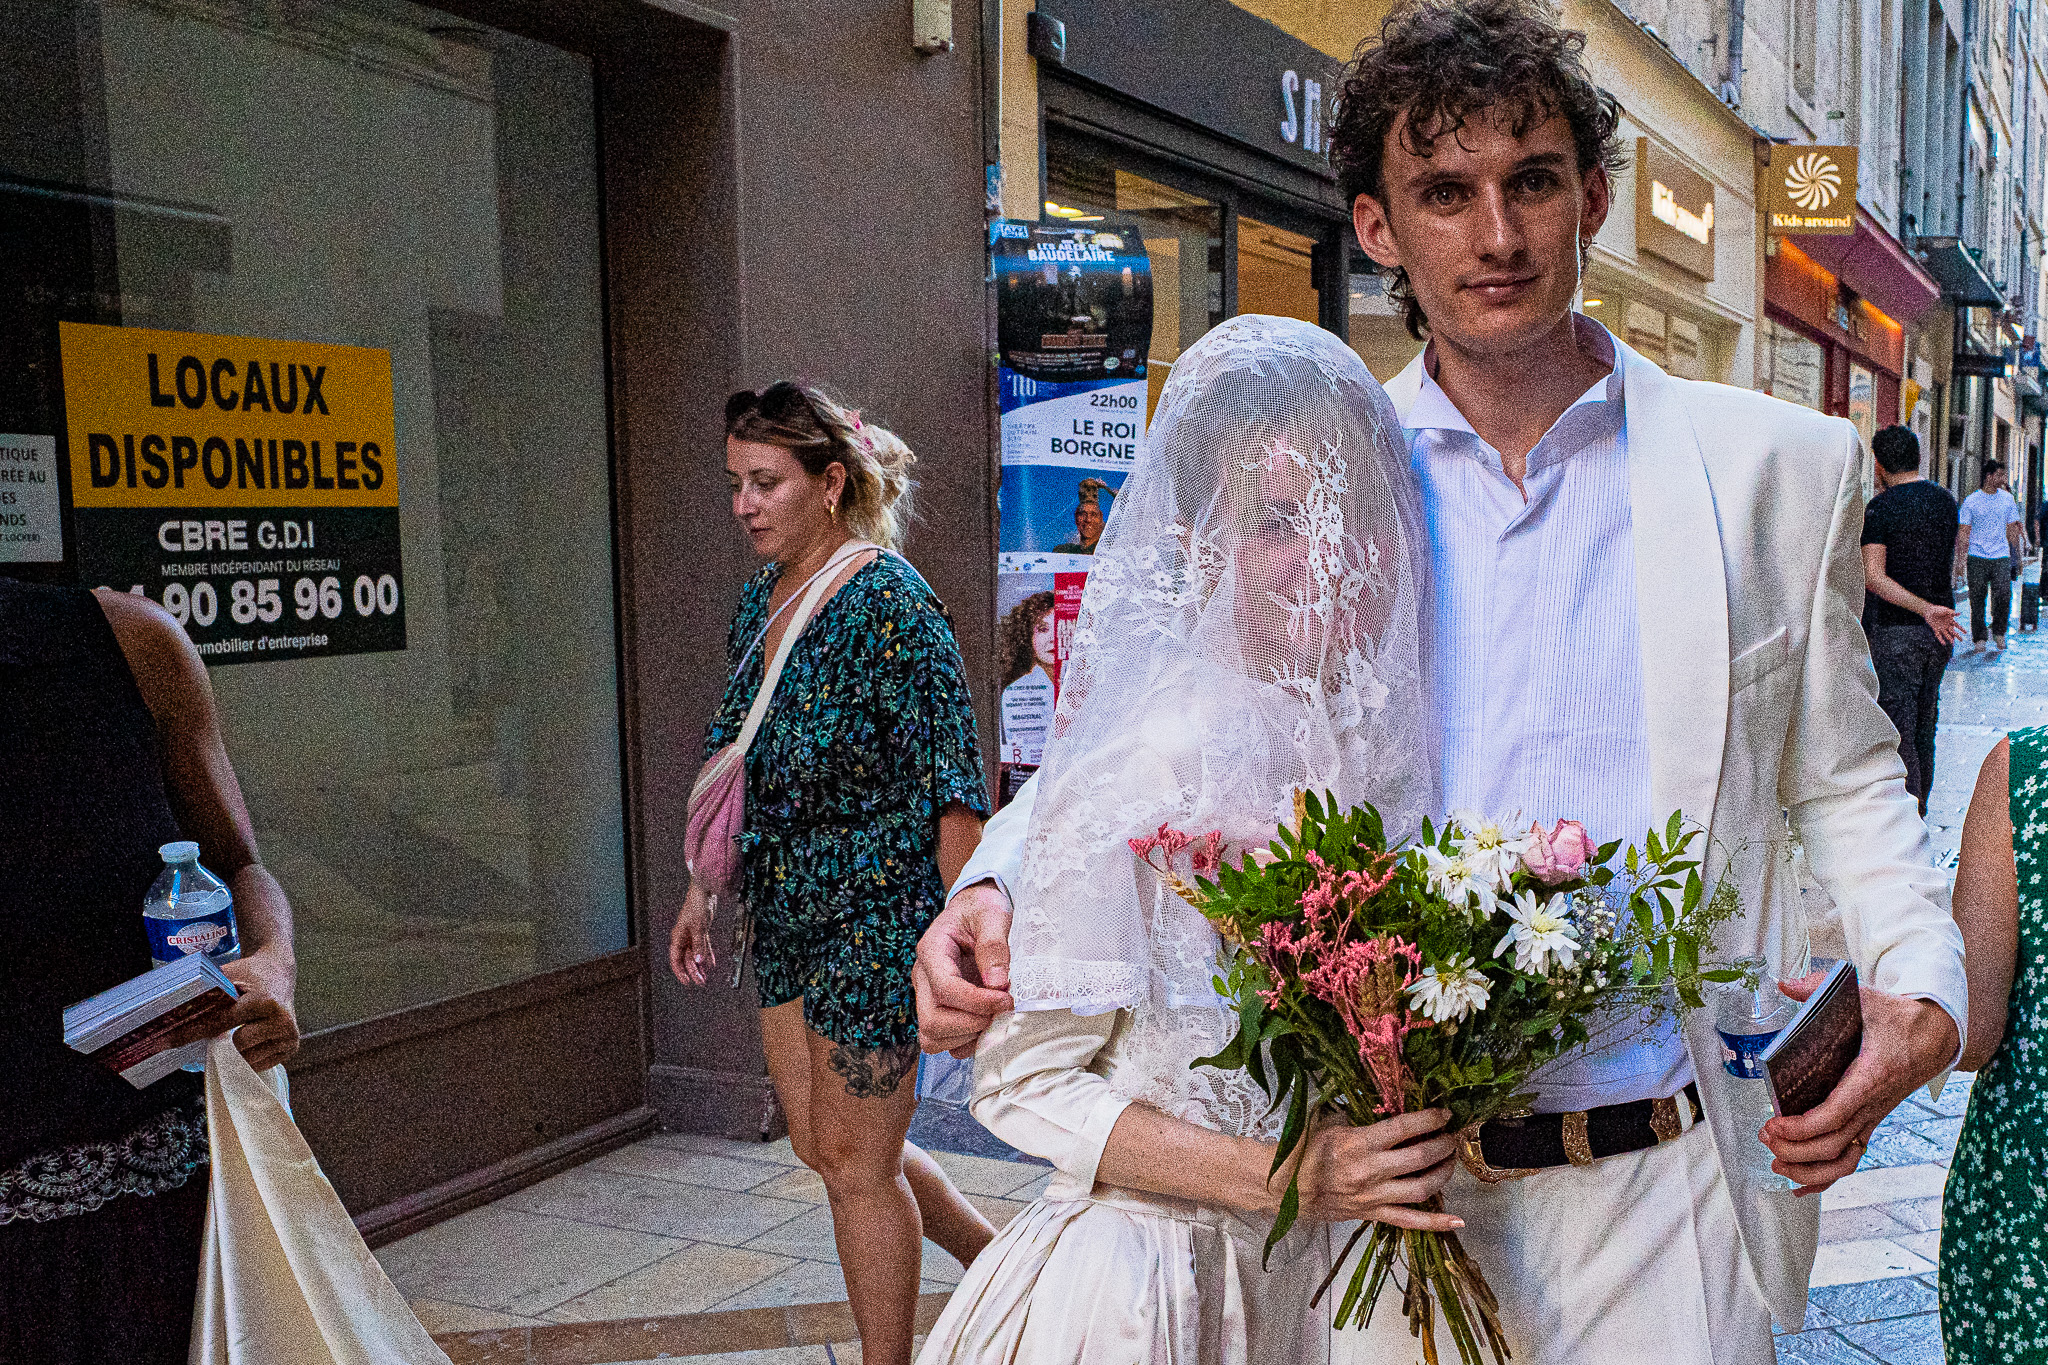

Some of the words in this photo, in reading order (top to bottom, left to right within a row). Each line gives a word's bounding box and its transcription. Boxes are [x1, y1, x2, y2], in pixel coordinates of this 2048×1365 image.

[1773, 213, 1803, 227] Kids
[1804, 214, 1851, 227] around
[1027, 249, 1115, 262] BAUDELAIRE
[147, 353, 330, 416] LOCAUX
[1090, 394, 1138, 409] 22h00
[1073, 419, 1095, 436] LE
[1102, 422, 1136, 440] ROI
[1051, 437, 1135, 460] BORGNE
[88, 433, 384, 490] DISPONIBLES
[28, 470, 46, 483] AU
[158, 519, 248, 551] CBRE
[257, 520, 315, 550] G.D.I
[161, 562, 209, 576] MEMBRE
[211, 560, 284, 575] INDÉPENDANT
[287, 560, 301, 572] DU
[302, 558, 340, 571] RÉSEAU
[163, 582, 218, 626] 90
[231, 579, 283, 624] 85
[294, 576, 342, 620] 96
[353, 574, 399, 616] 00
[196, 638, 255, 655] mmobilier
[257, 634, 328, 652] d'entreprise
